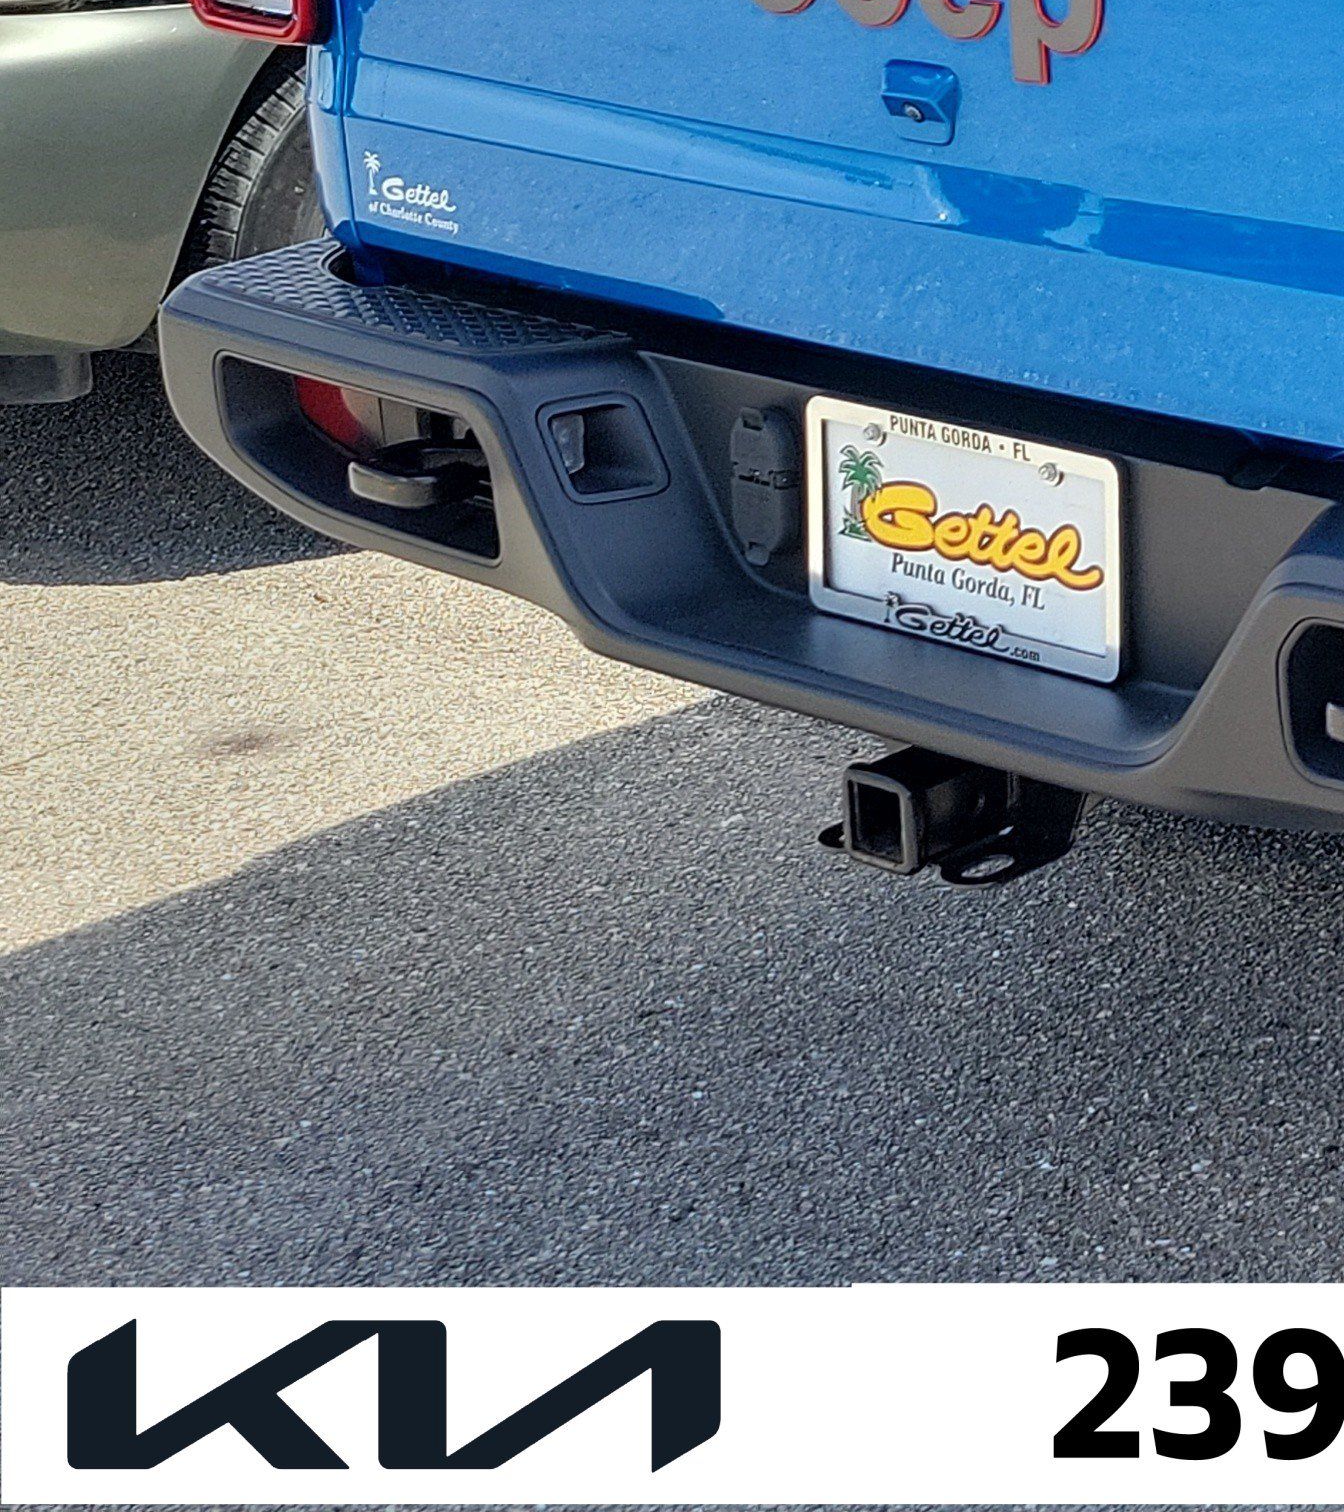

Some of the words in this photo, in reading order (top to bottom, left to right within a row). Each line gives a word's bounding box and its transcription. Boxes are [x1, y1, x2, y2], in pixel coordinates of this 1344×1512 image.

[381, 176, 458, 212] Gettel
[889, 414, 937, 441] PUNTA
[941, 426, 992, 453] GORDA
[1012, 441, 1032, 462] FL
[860, 480, 1105, 591] Gettel
[890, 552, 945, 586] Punta
[951, 567, 1016, 607] Gorda,
[1020, 585, 1046, 611] FL
